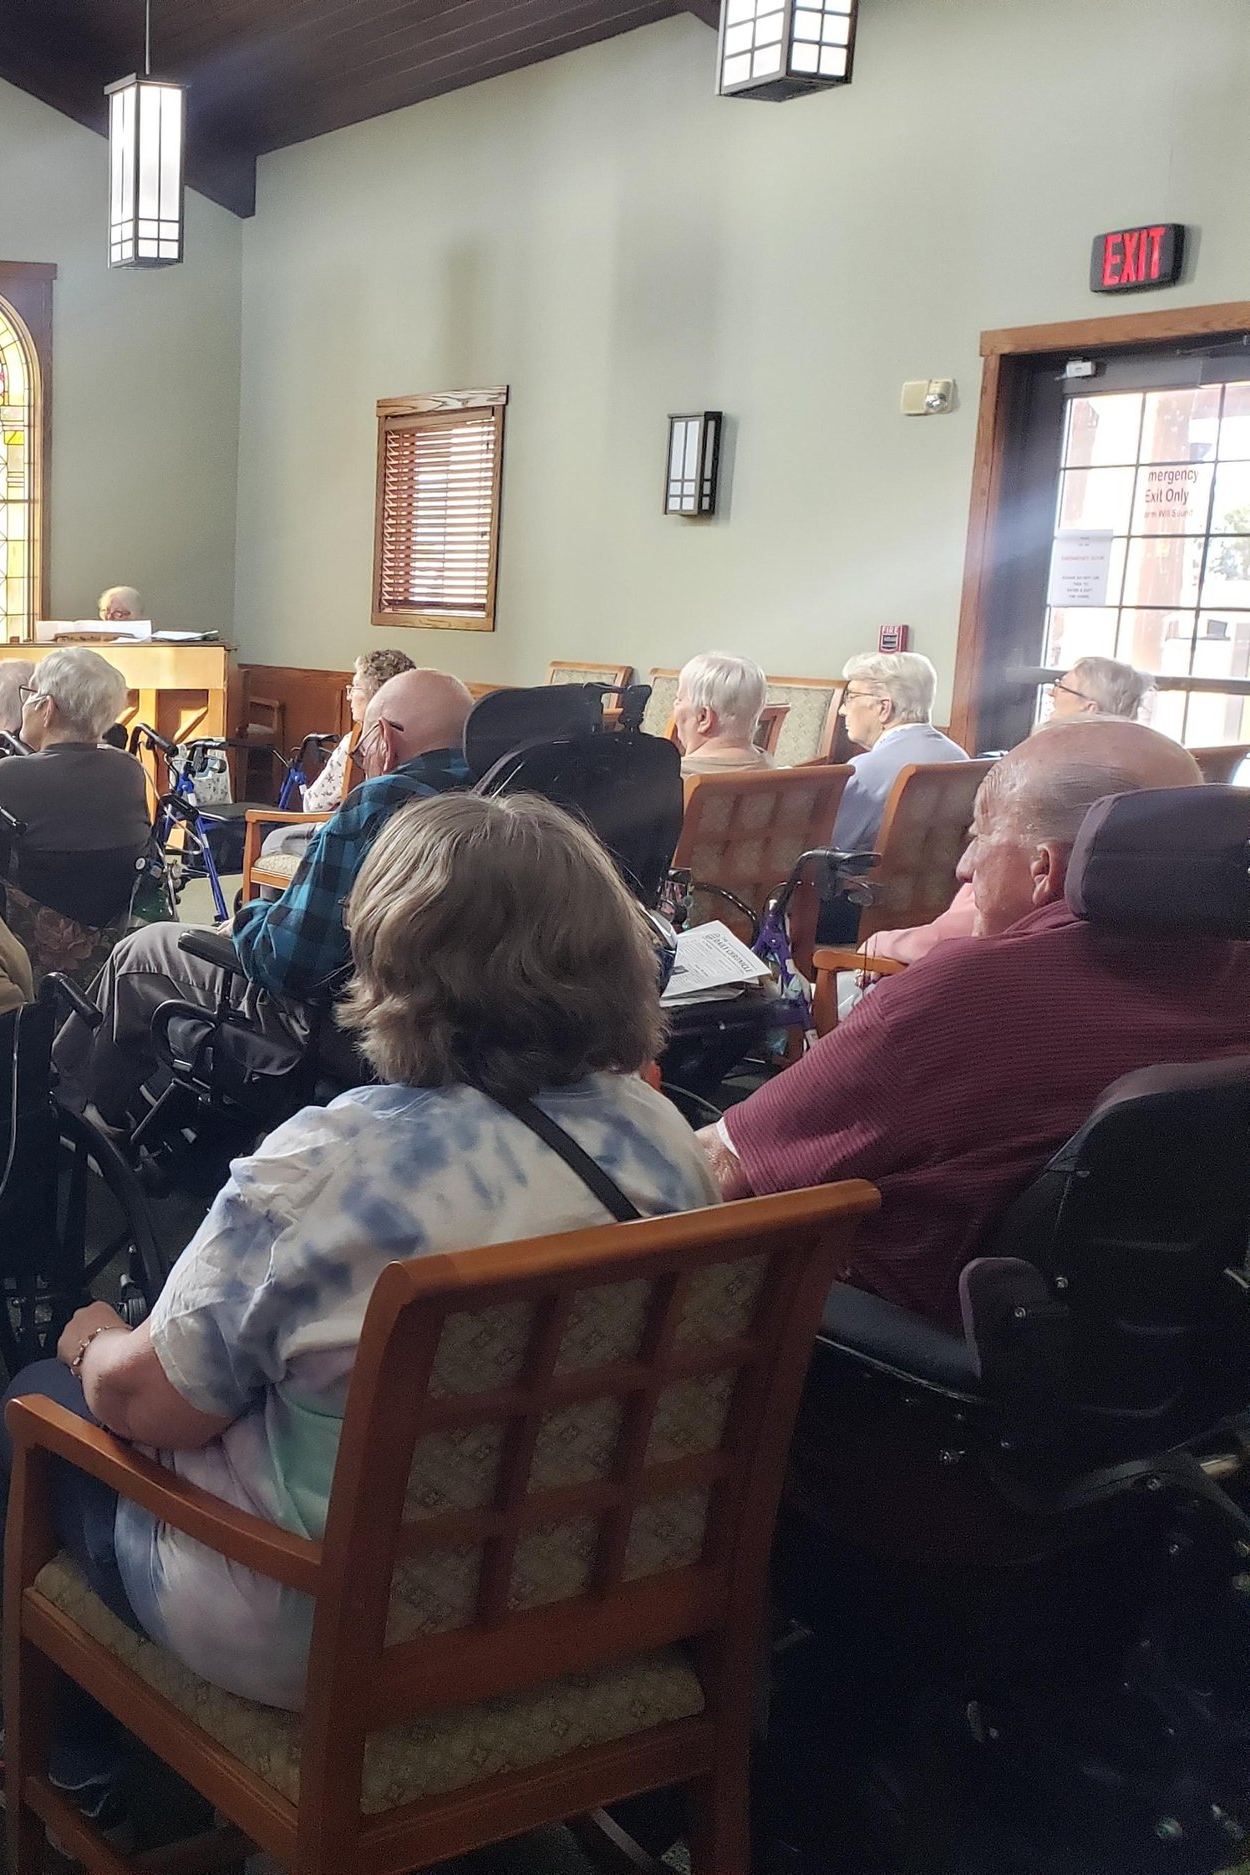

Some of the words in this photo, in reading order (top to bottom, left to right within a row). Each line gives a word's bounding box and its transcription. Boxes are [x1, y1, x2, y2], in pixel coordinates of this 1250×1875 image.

[1103, 226, 1166, 286] EXIT
[1148, 470, 1198, 485] mergency
[1145, 488, 1163, 503] Exit
[1165, 487, 1189, 505] Only
[882, 625, 899, 634] FIRE
